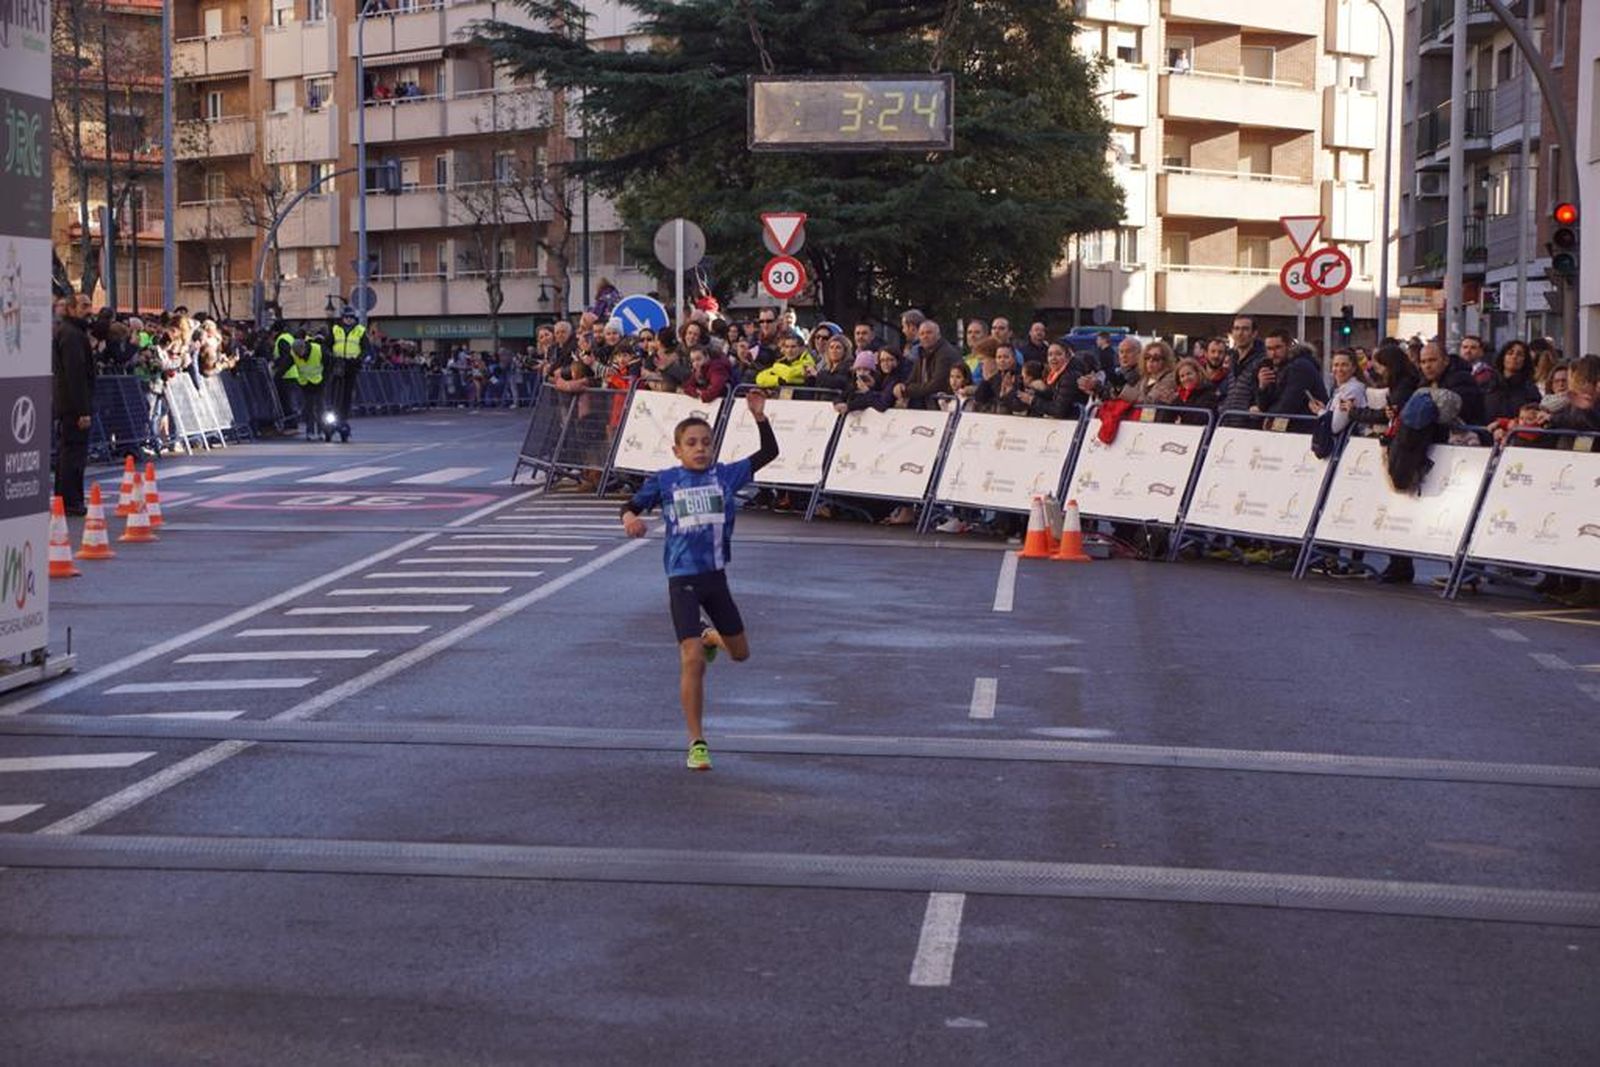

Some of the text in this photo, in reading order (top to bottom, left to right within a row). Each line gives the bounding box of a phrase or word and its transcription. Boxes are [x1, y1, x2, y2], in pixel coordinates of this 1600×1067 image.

[839, 92, 938, 131] 3:24
[772, 271, 795, 285] 30
[5, 450, 40, 473] HYUNDAI
